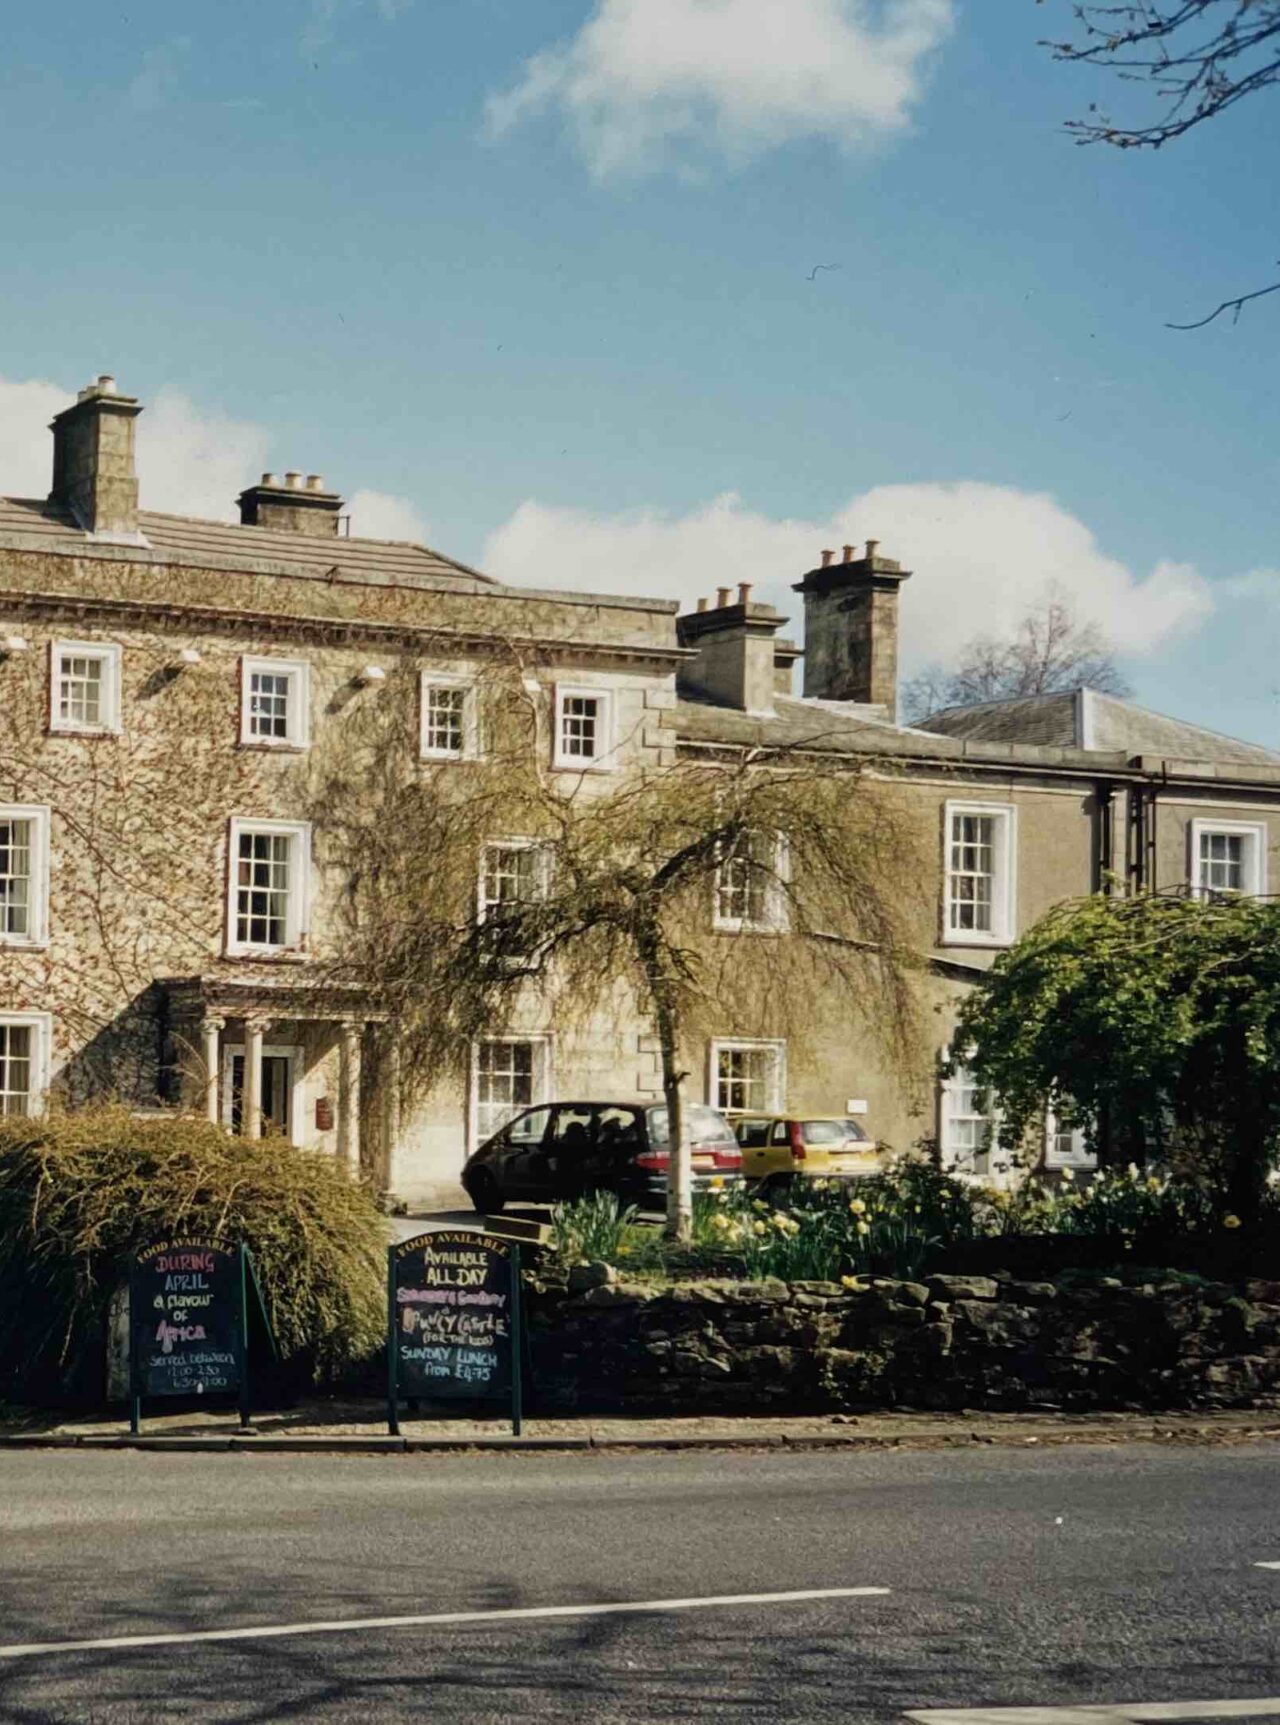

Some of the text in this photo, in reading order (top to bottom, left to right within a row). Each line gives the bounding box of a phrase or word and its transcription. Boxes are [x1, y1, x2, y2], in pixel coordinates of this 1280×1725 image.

[137, 1238, 234, 1263] FOOD AVAILABLE
[398, 1234, 508, 1257] FOOD AVAILABLE
[155, 1253, 215, 1272] DURING
[165, 1274, 209, 1291] APRIL
[426, 1269, 488, 1286] ALL DAY
[173, 1310, 188, 1322] of
[401, 1346, 497, 1367] SUNDAY LUNCH
